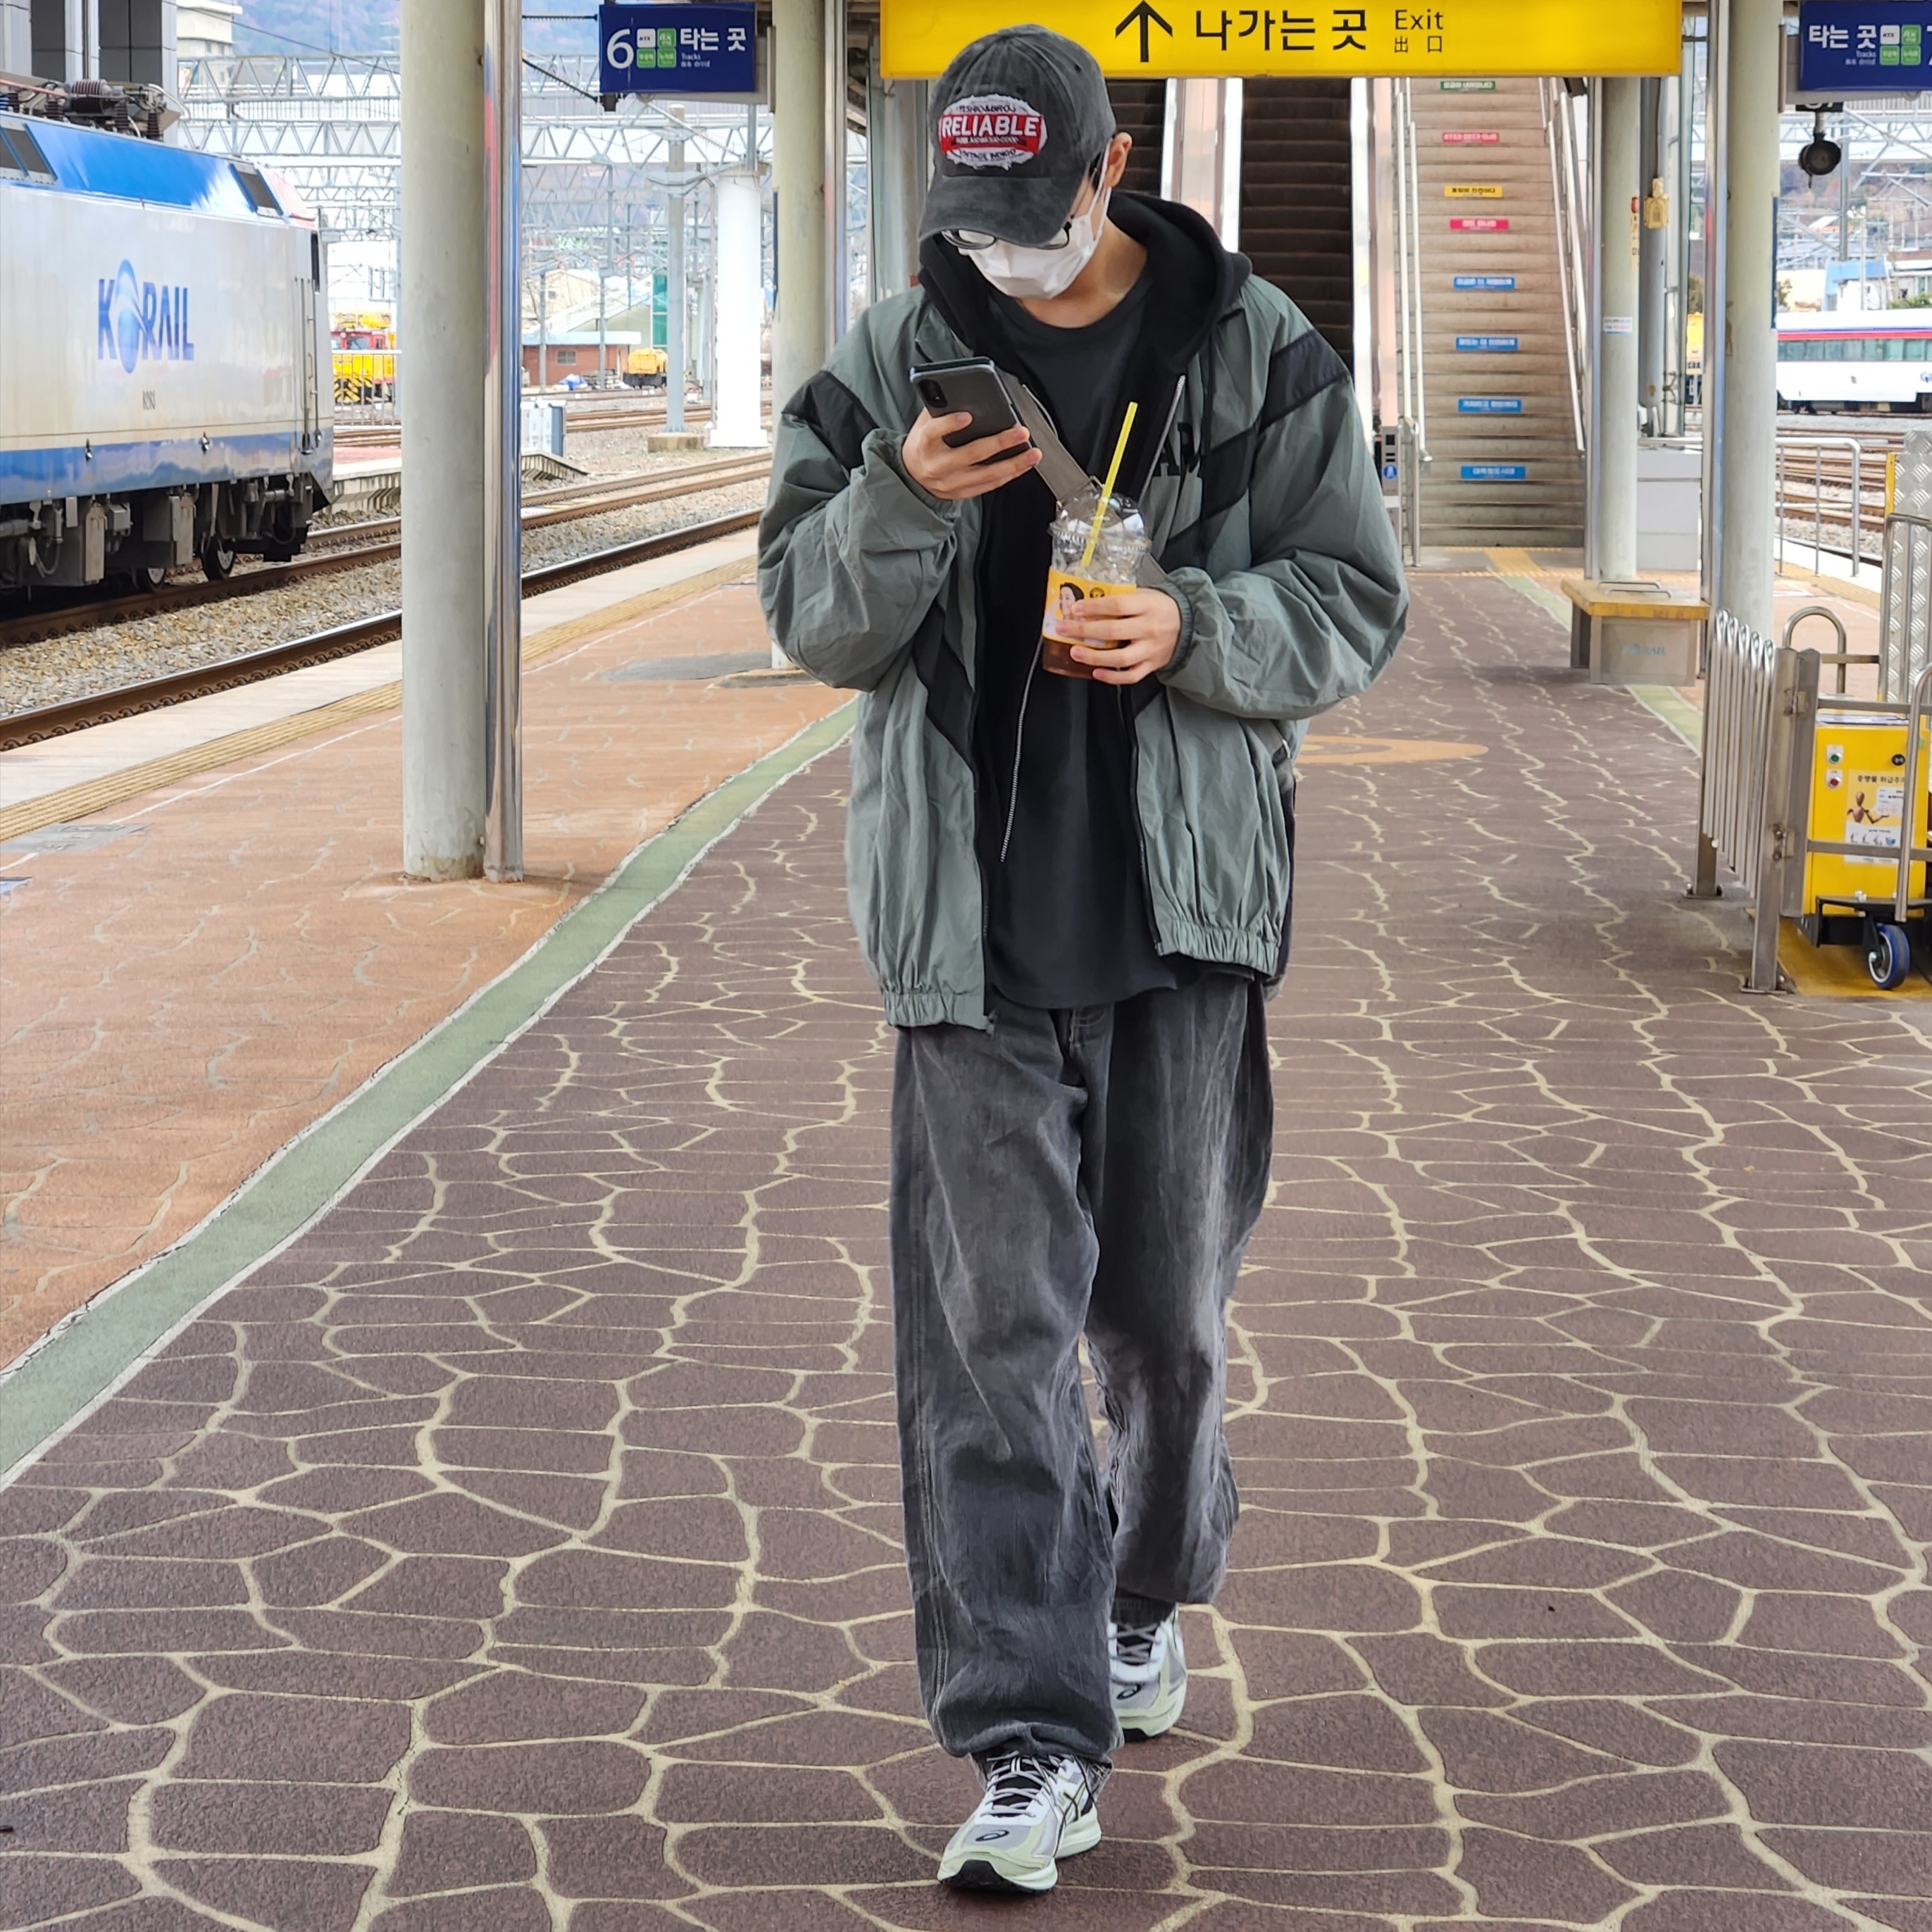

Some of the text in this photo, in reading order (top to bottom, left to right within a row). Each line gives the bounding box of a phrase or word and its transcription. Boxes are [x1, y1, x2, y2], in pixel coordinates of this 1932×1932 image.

[1196, 9, 1367, 51] 나가는 곳
[1395, 8, 1444, 30] Exit
[606, 28, 634, 69] 6
[680, 27, 719, 51] 타는
[727, 27, 747, 51] 곳
[1394, 35, 1442, 54] 出口
[1809, 25, 1849, 49] 타는
[1857, 25, 1877, 49] 곳
[942, 115, 1040, 139] RELIABLE
[97, 258, 195, 375] KORAIL
